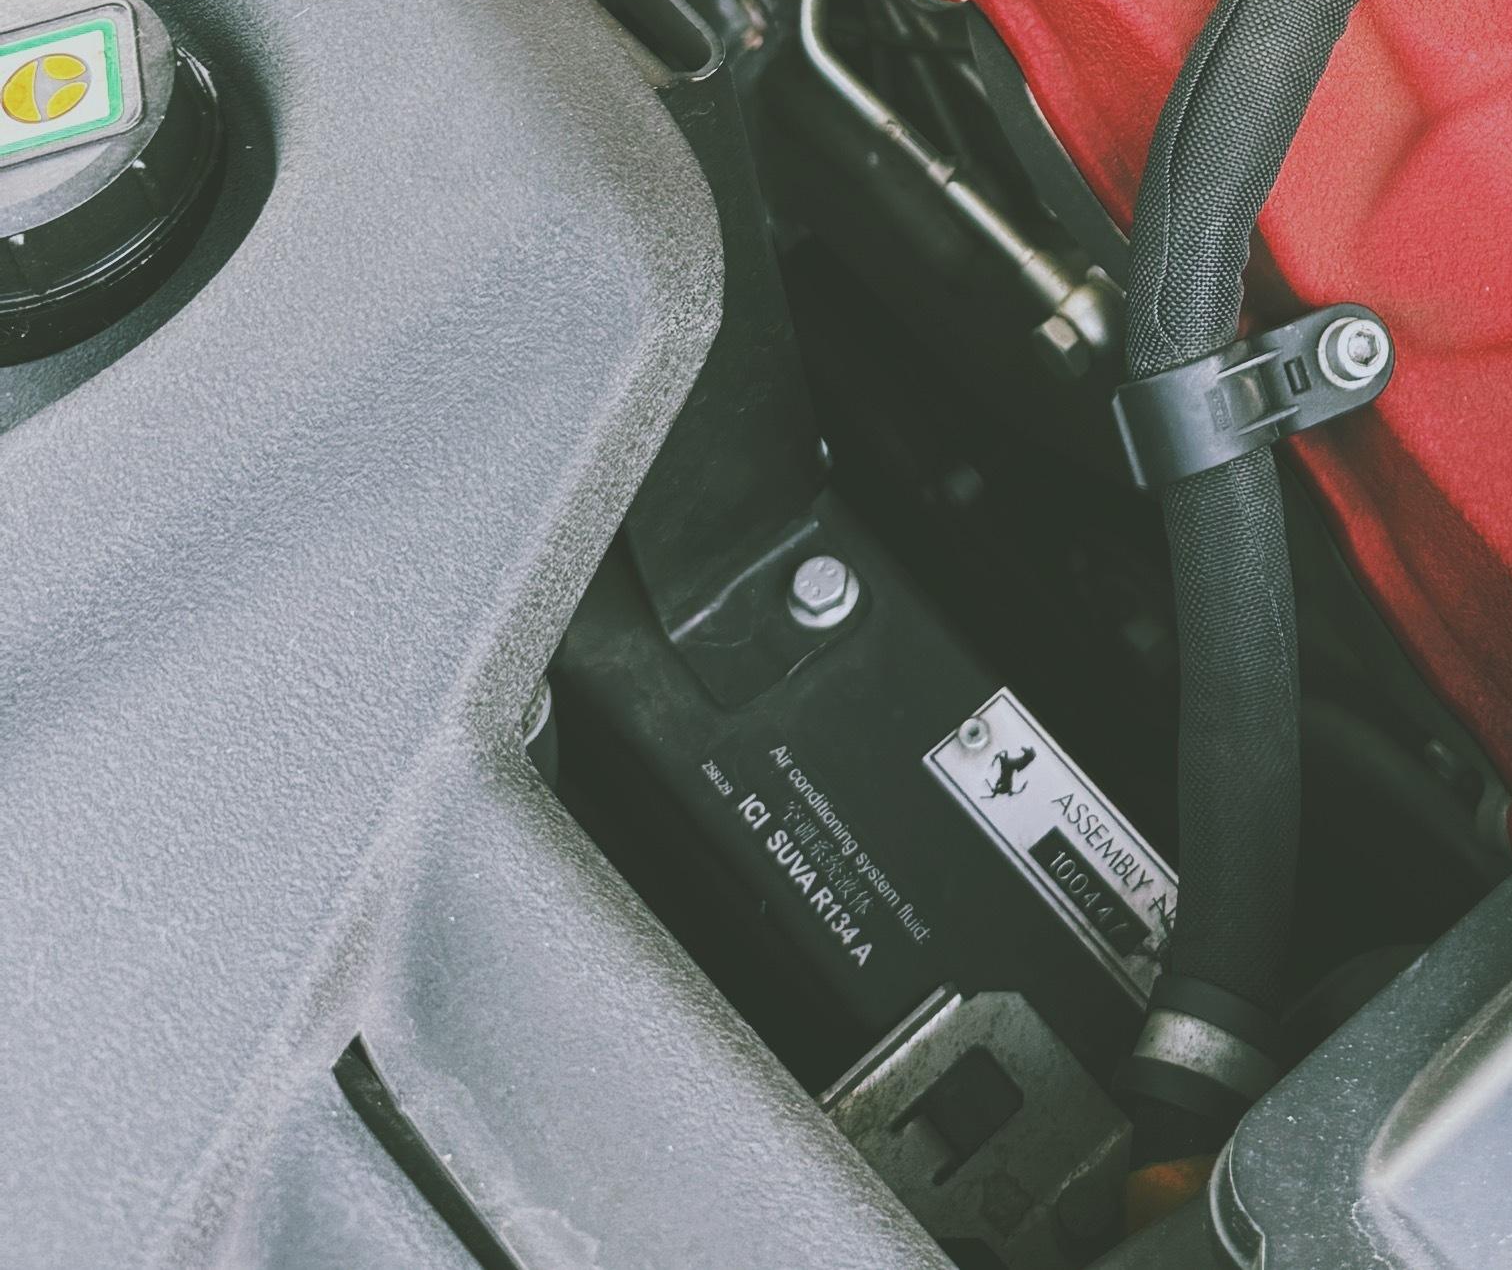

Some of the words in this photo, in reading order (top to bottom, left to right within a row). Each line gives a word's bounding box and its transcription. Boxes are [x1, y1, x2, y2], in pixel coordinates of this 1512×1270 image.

[737, 793, 771, 829] ICI
[766, 829, 818, 895] SUVA
[768, 745, 794, 768] Air
[789, 768, 859, 856] conditioning
[856, 852, 900, 906] system
[896, 903, 931, 945] fluid:
[1051, 793, 1154, 892] ASSEMBLY
